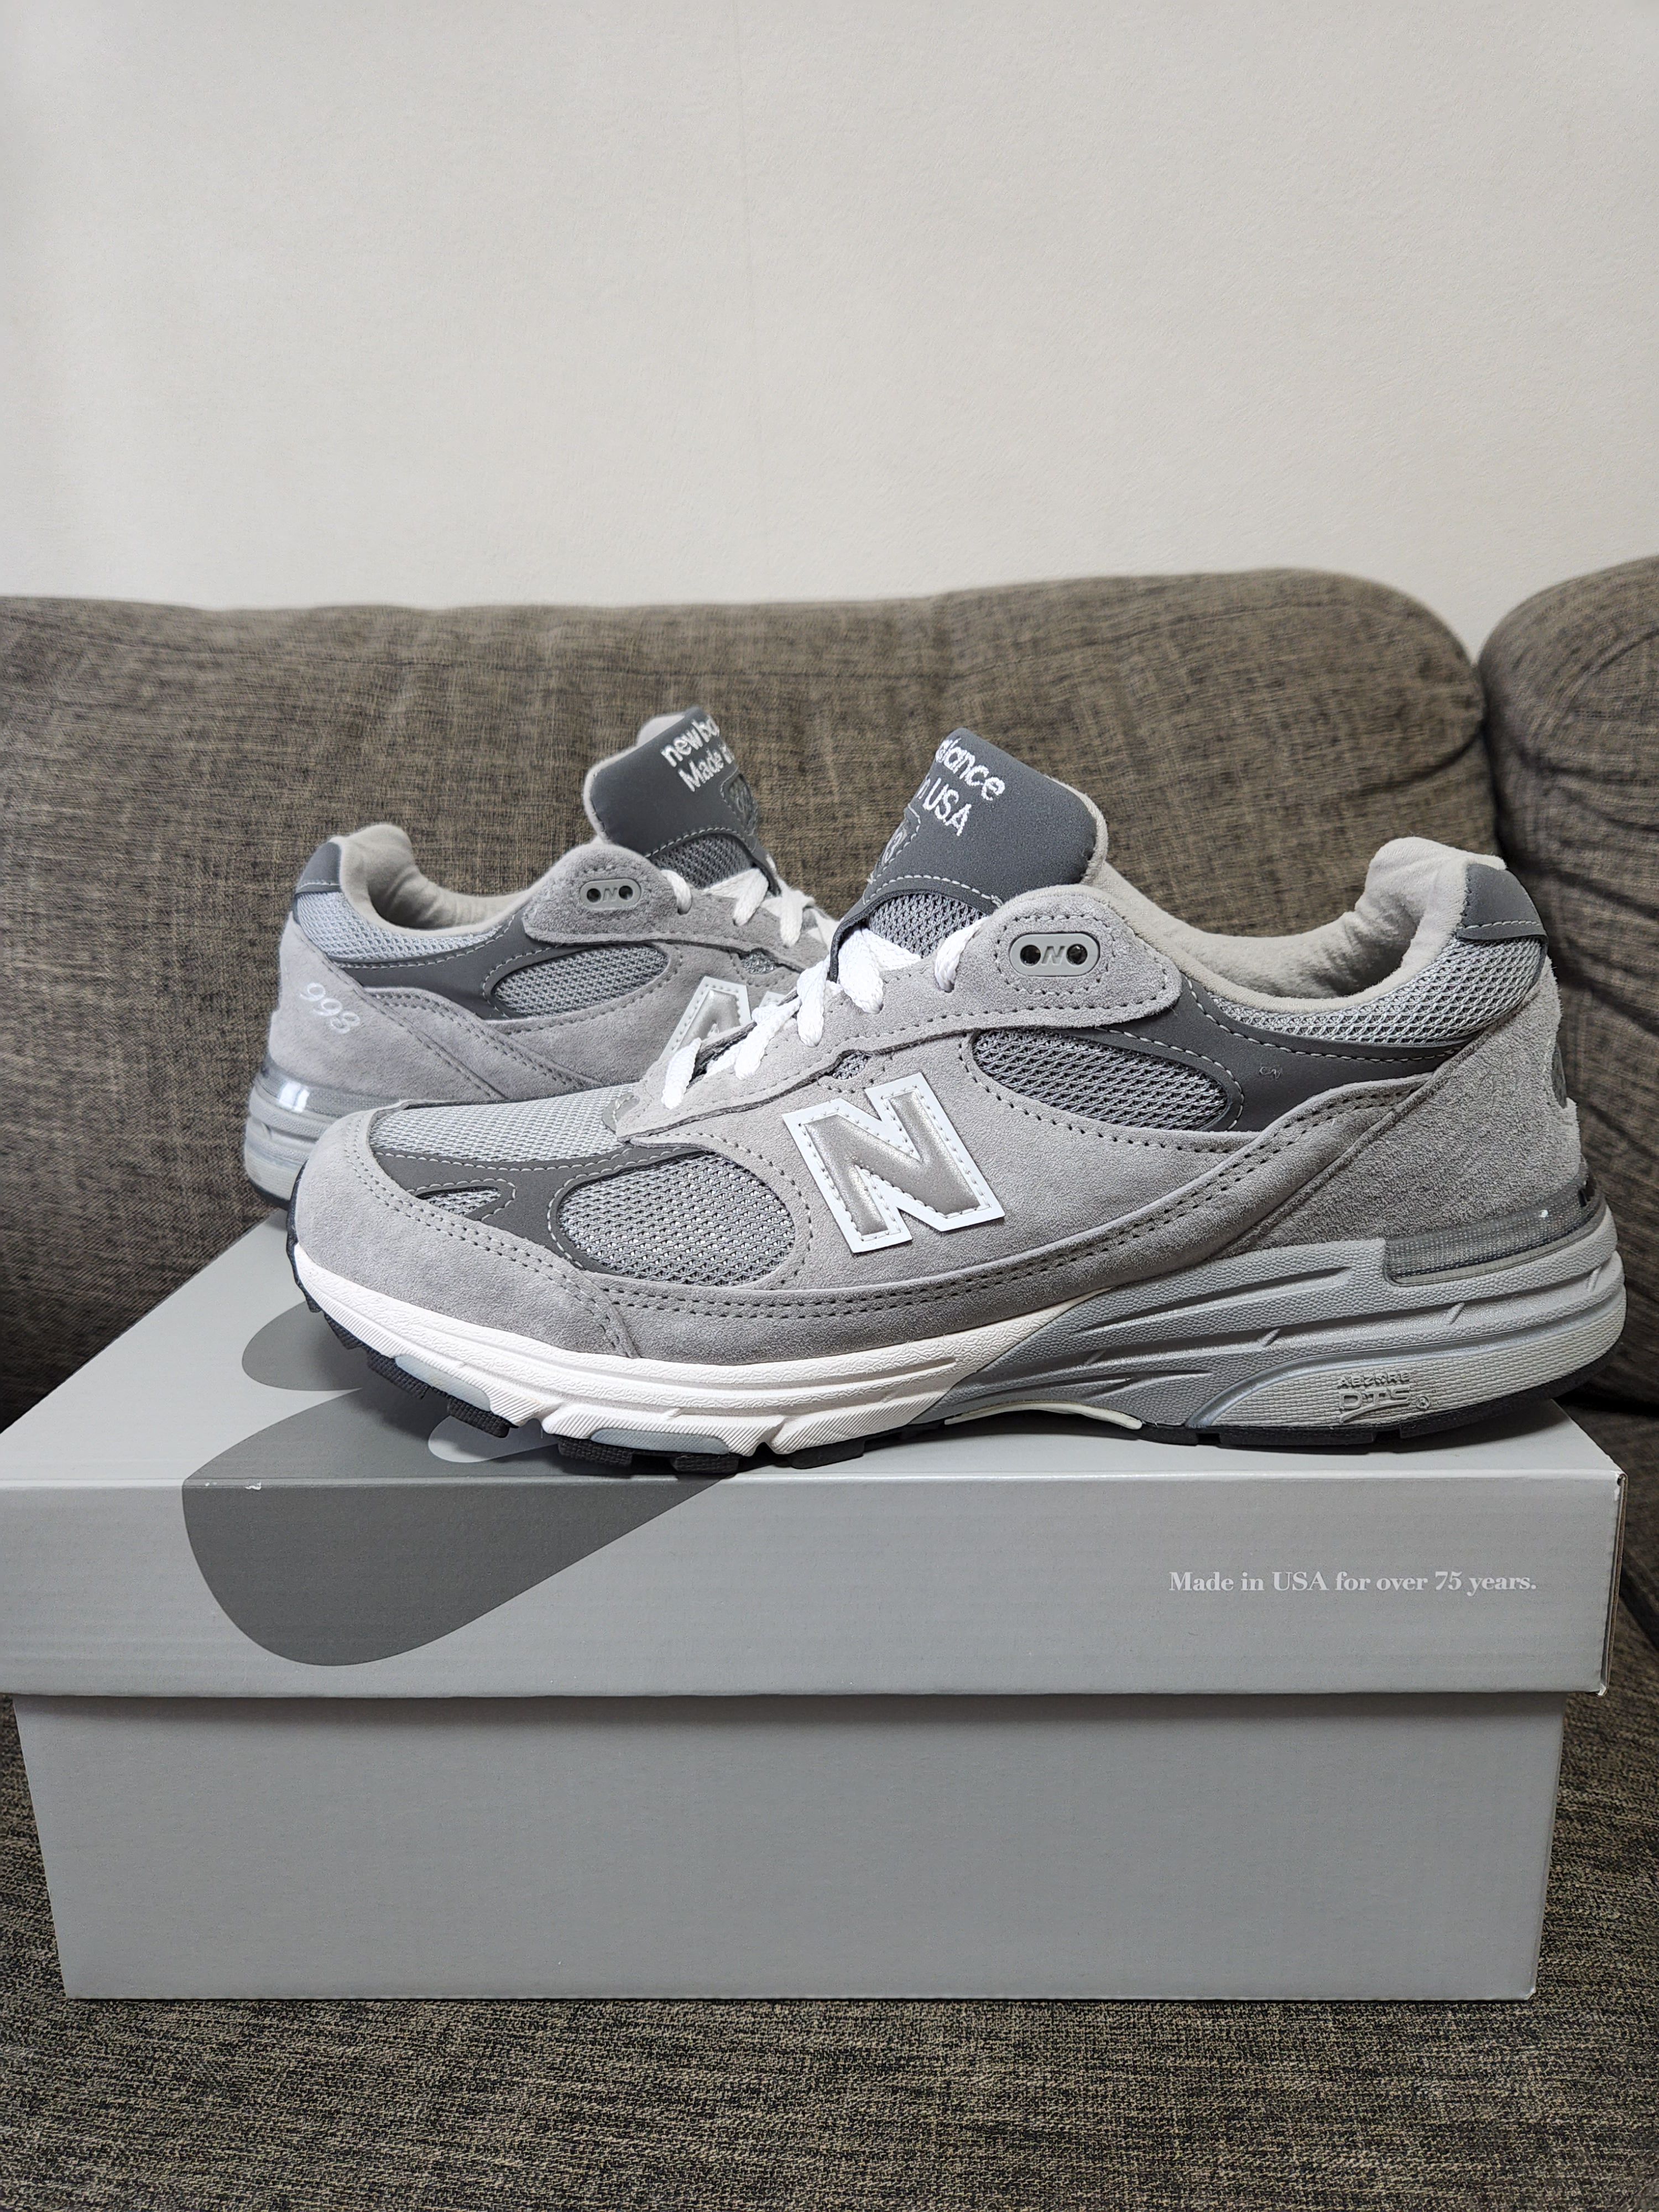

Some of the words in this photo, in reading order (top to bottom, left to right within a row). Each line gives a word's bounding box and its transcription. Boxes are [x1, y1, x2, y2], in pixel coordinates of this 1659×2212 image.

[678, 748, 724, 792] Made
[922, 778, 972, 836] USA
[300, 982, 361, 1034] 993
[782, 1072, 1005, 1254] N
[1339, 1384, 1411, 1411] DTS
[1168, 1572, 1234, 1592] Made
[1240, 1572, 1265, 1592] in
[1272, 1571, 1329, 1591] USA
[1335, 1571, 1371, 1591] for
[1376, 1578, 1428, 1591] over
[1435, 1571, 1462, 1590] 75
[1467, 1577, 1537, 1597] years.
